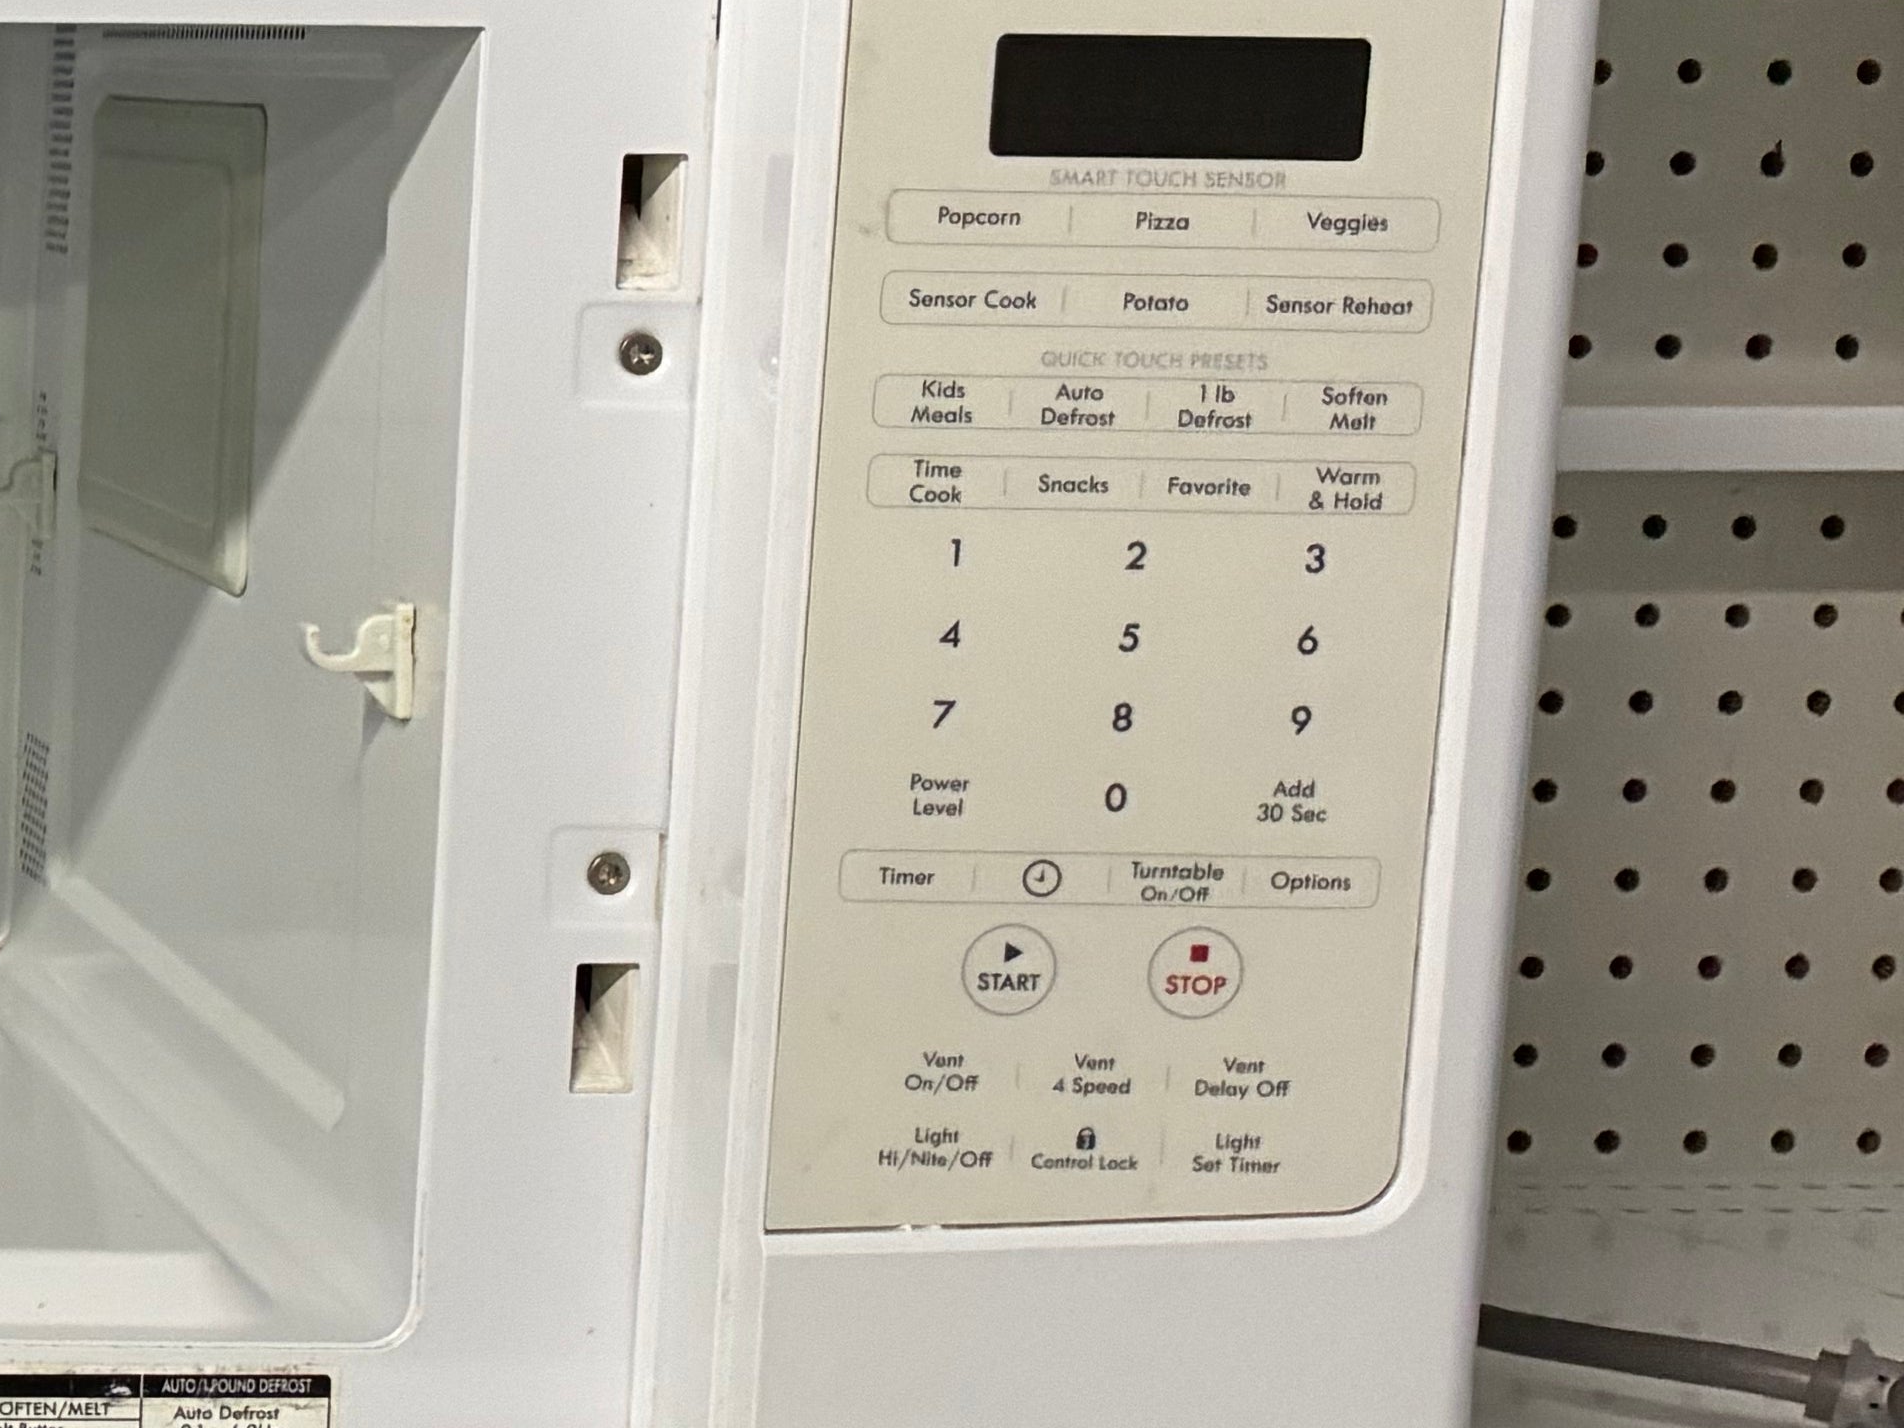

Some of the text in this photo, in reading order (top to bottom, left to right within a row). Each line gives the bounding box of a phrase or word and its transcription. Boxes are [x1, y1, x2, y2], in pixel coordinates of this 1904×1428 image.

[1050, 169, 1286, 189] SMART TOUCH SENSOR
[938, 206, 1021, 229] Popcorn
[1136, 212, 1189, 230] Pizza
[1307, 212, 1388, 235] Veggies
[909, 289, 1036, 309] Sensor Cook
[1124, 292, 1189, 311] Potato
[1266, 294, 1413, 315] Sensor Reheat
[1041, 349, 1268, 371] QUICK TOUCH PRESETS
[922, 380, 965, 398] Kids
[1055, 384, 1104, 401] Auto
[1201, 384, 1235, 403] 1 lb
[1322, 386, 1387, 405] Soften
[911, 405, 972, 423] Meals
[1041, 407, 1115, 426] Defrost
[1178, 409, 1252, 428] Defrost
[1329, 413, 1376, 430] Melt
[914, 459, 962, 478] Time
[1316, 467, 1380, 485] Warm
[910, 484, 961, 503] Cook
[1039, 474, 1108, 493] Snacks
[1168, 476, 1251, 496] Favorite
[1309, 491, 1382, 510] & Hold
[952, 539, 961, 567] 1
[1125, 541, 1147, 570] 2
[1305, 543, 1325, 573] 3
[940, 620, 960, 648] 4
[1119, 623, 1140, 652] 5
[1297, 625, 1318, 655] 6
[933, 700, 956, 729] 7
[1112, 703, 1132, 732] 8
[1292, 706, 1312, 735] 9
[910, 773, 969, 792] Power
[1273, 780, 1315, 798] Add
[913, 798, 963, 816] Level
[1105, 783, 1127, 812] 0
[1257, 803, 1326, 823] 30 Sec
[880, 867, 935, 885] Timer
[1132, 861, 1224, 881] Turntable
[1271, 871, 1351, 894] Options
[1141, 886, 1209, 907] On/Off
[978, 973, 1041, 991] START
[1165, 974, 1227, 995] STOP
[923, 1051, 964, 1068] Vent
[1075, 1053, 1115, 1071] Vent
[1223, 1057, 1265, 1074] Vent
[905, 1074, 979, 1095] On/Off
[1052, 1077, 1131, 1097] 4 Speed
[1195, 1079, 1291, 1100] Delay Off
[915, 1127, 959, 1148] Light
[1216, 1133, 1261, 1154] Light
[879, 1149, 993, 1171] Hi/Nite/Off
[1031, 1153, 1138, 1170] Control Lock
[1193, 1155, 1280, 1173] Set Timer
[259, 1379, 312, 1393] DEFROST
[173, 1404, 279, 1420] Auto Defrost
